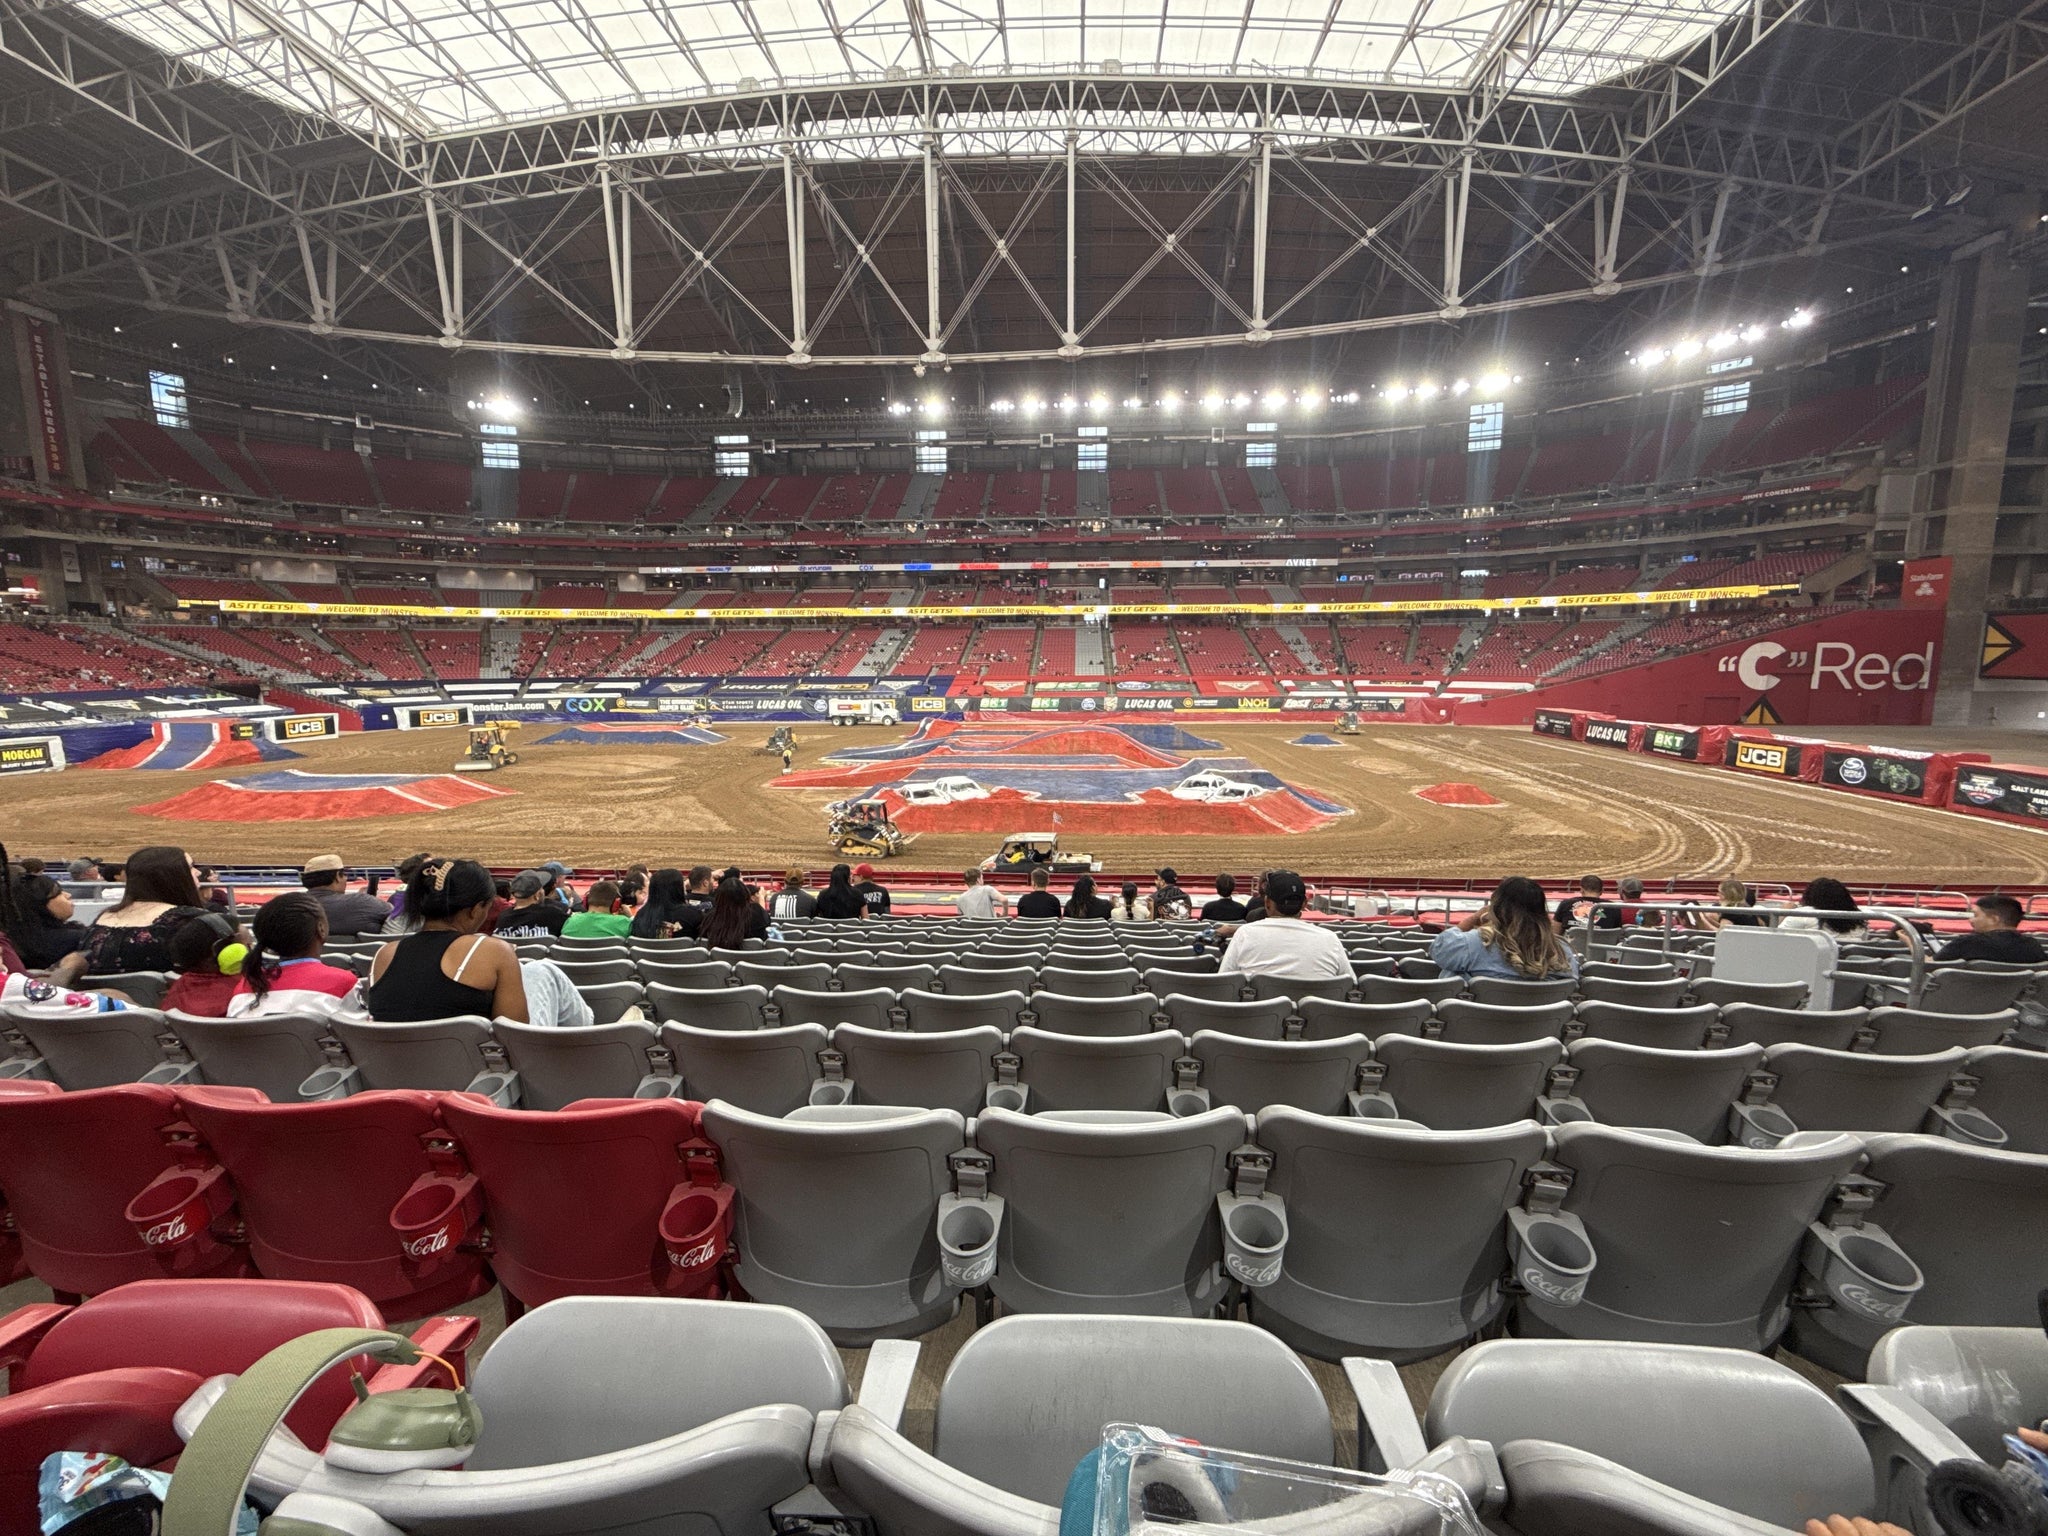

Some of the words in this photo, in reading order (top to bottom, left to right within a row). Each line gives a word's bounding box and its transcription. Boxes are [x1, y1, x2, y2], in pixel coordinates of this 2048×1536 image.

[34, 335, 56, 434] ESTABLISHED
[1741, 493, 1764, 501] JIMMY
[1764, 485, 1811, 497] CONZELMAN
[1589, 595, 1622, 603] GETS!
[1656, 591, 1694, 600] WELCOME
[1810, 641, 1934, 690] Red
[566, 697, 606, 712] COX
[757, 700, 786, 709] LUCAS
[787, 700, 803, 709] OIL
[914, 700, 943, 709] JCB
[981, 698, 1007, 707] BKT
[1032, 698, 1059, 707] BKT
[1125, 699, 1156, 708] LUCAS
[1157, 699, 1173, 708] OIL
[1238, 698, 1269, 707] UNOH
[424, 712, 456, 723] JCB
[289, 721, 322, 734] JCB
[1587, 725, 1612, 740] LUCAS
[1613, 729, 1627, 743] OIL
[1655, 732, 1684, 748] BKT
[2, 748, 43, 761] MORGAN
[1741, 748, 1782, 767] JCB
[2010, 785, 2029, 793] SALT
[1227, 1253, 1282, 1282] Coca-Col
